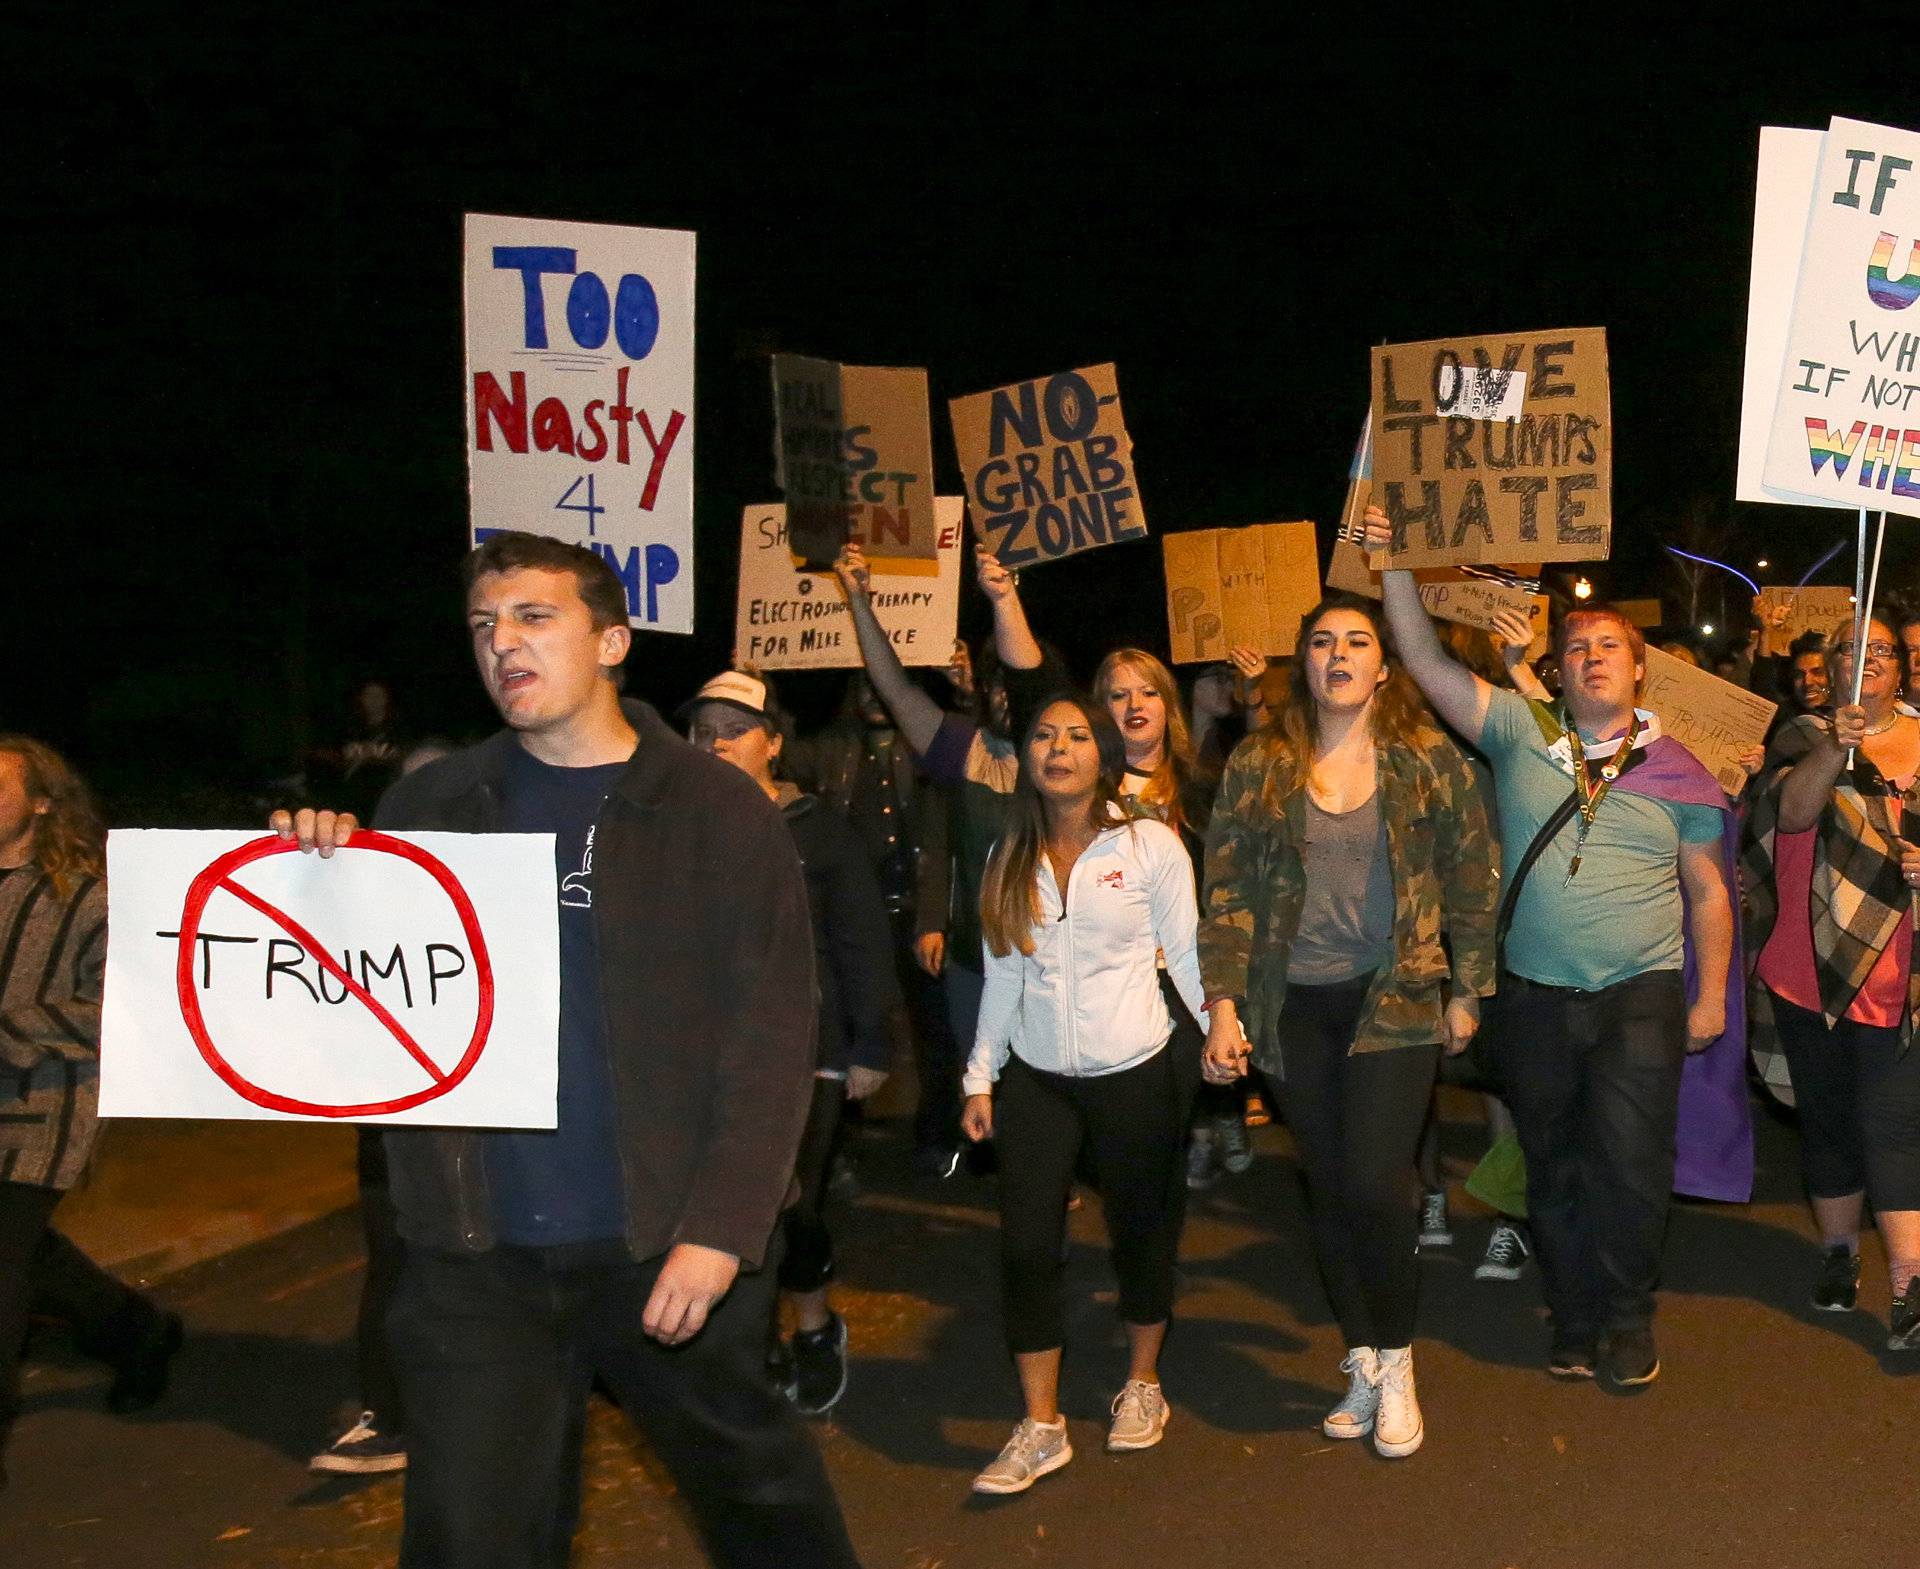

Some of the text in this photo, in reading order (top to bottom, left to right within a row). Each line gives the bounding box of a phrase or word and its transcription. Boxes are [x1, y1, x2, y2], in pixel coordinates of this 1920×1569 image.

[1832, 148, 1913, 216] IF
[492, 245, 660, 361] TOO
[1382, 340, 1576, 415] LOVE
[1792, 359, 1920, 411] IF NOT
[473, 365, 686, 512] Nasty
[975, 434, 1126, 514] GRAB
[1383, 412, 1602, 475] TRUMPS
[555, 473, 605, 536] 4
[984, 486, 1144, 566] ZONE
[1384, 473, 1609, 557] HATE
[1221, 571, 1266, 589] WITH
[751, 635, 788, 659] FOR
[156, 930, 466, 1009] TRUMP
